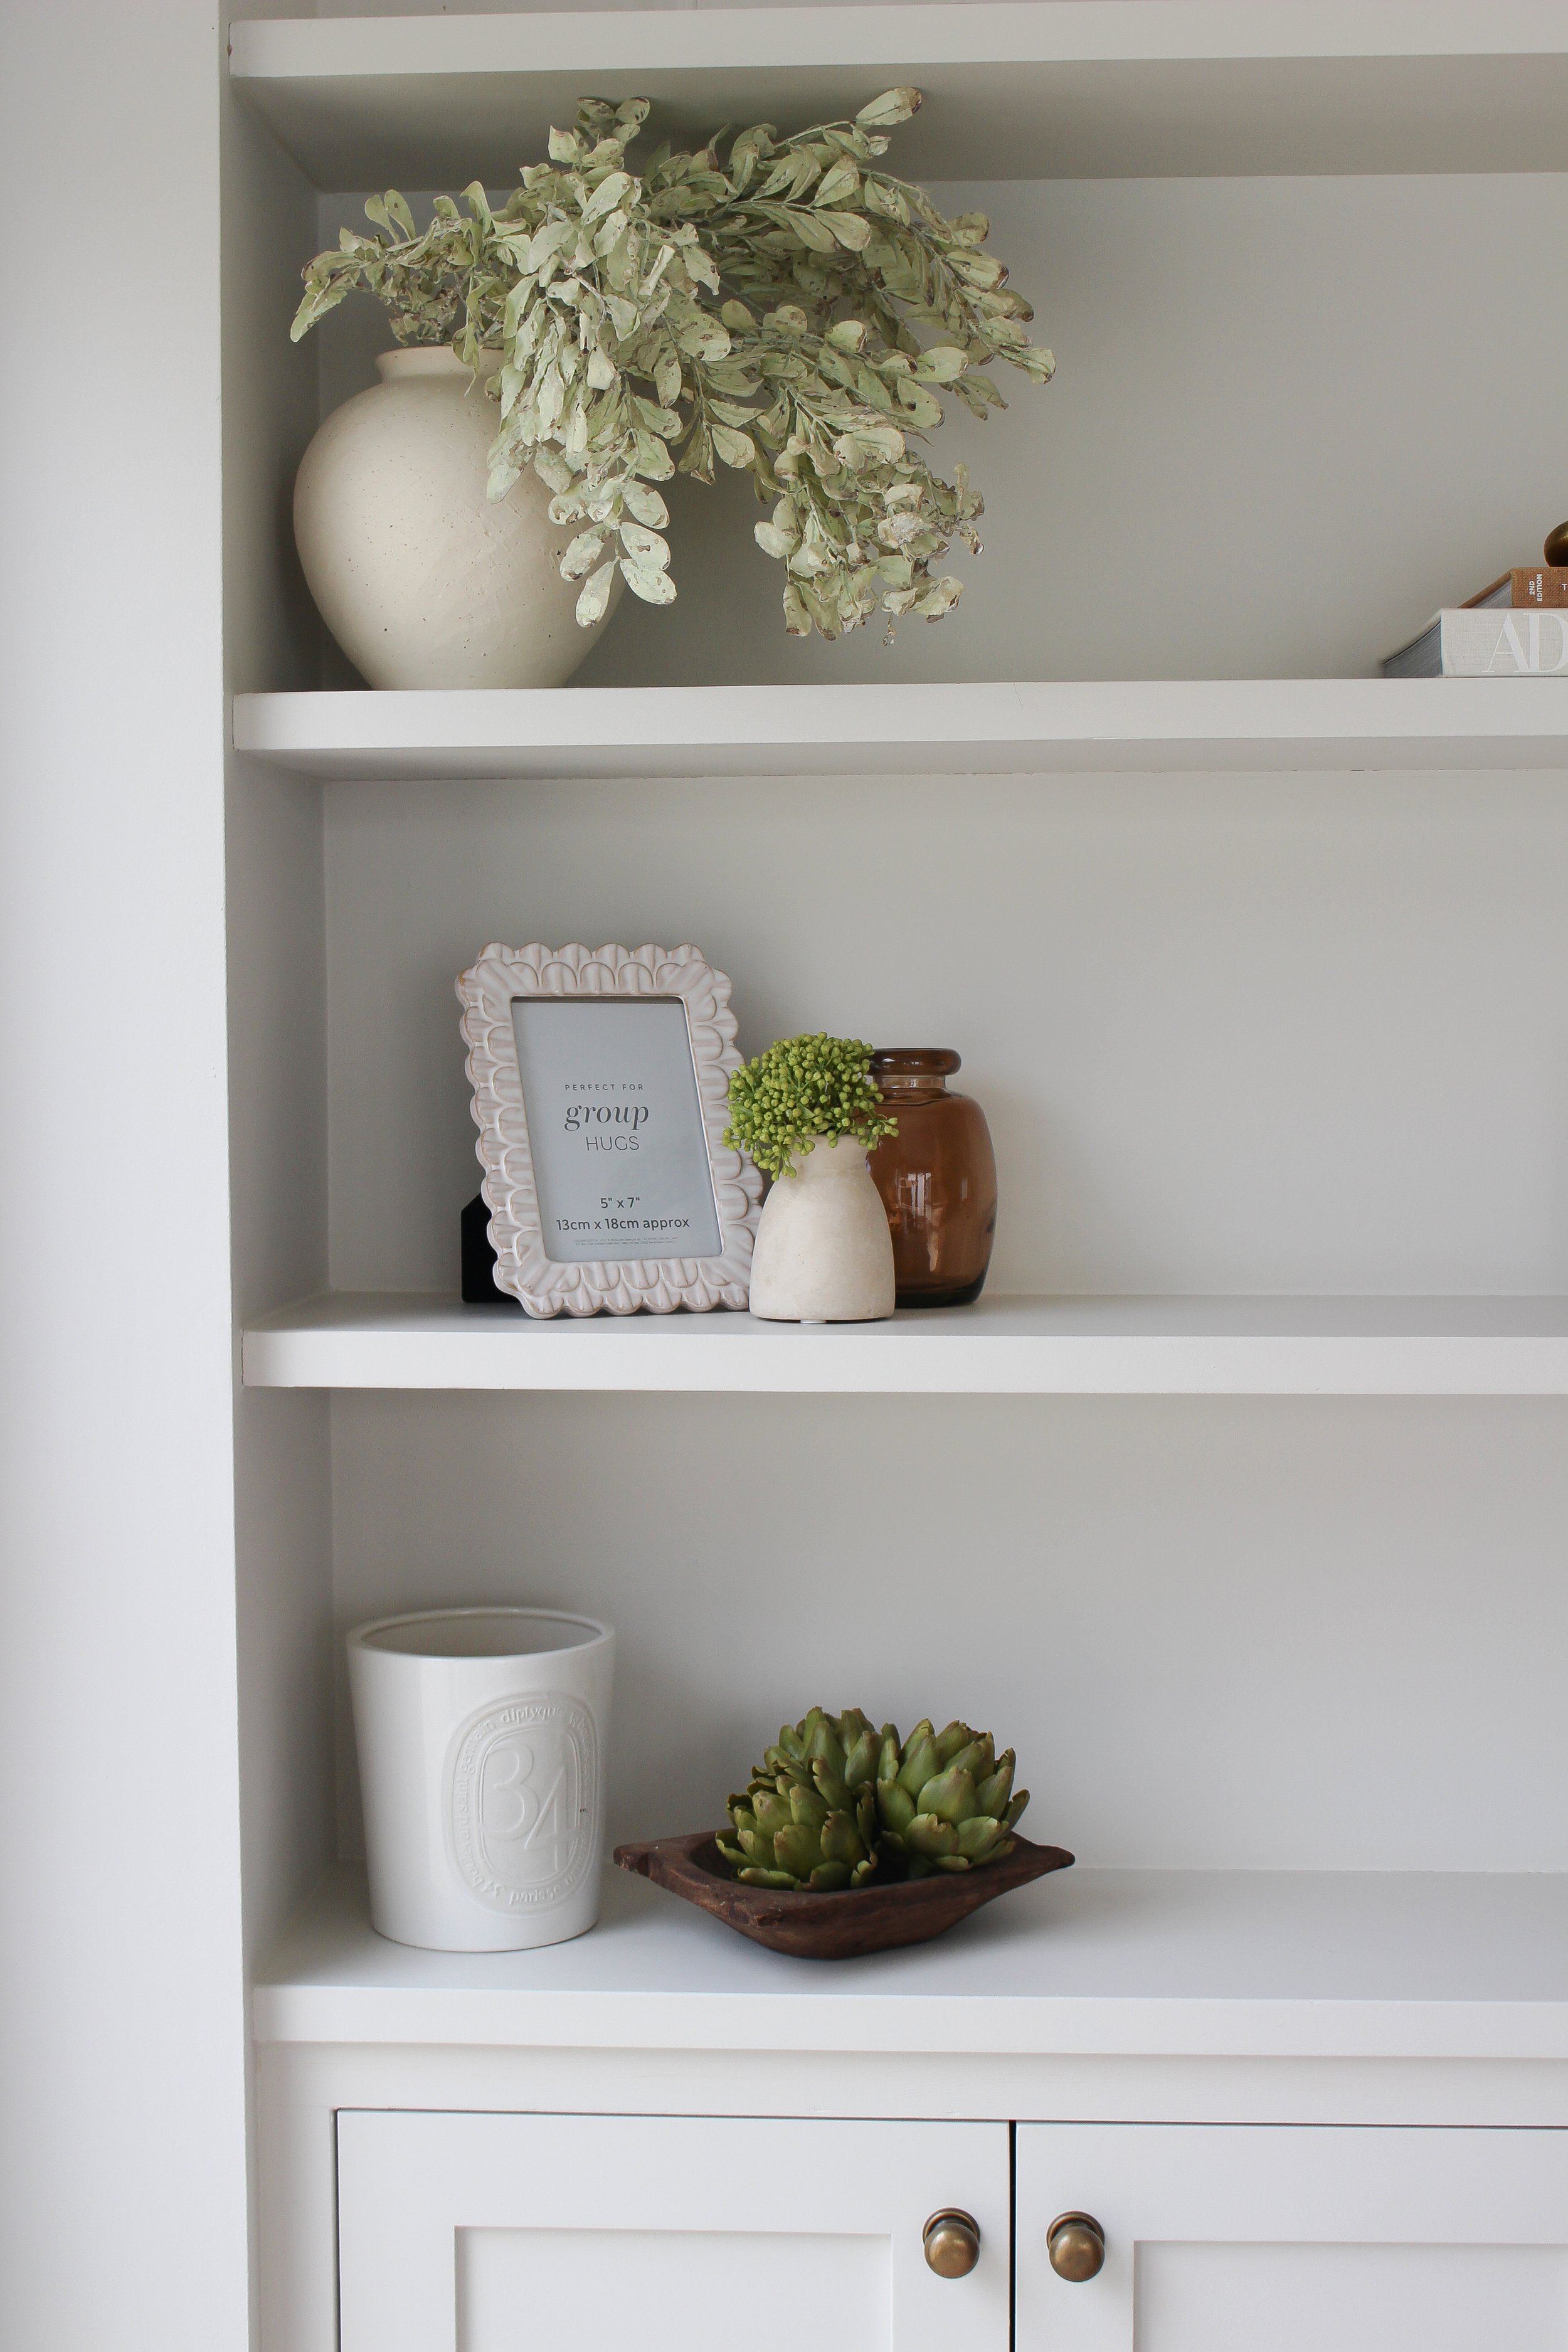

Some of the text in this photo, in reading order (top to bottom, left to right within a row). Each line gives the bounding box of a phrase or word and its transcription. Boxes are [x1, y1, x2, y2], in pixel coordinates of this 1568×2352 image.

[1481, 612, 1568, 673] AD
[622, 1083, 645, 1091] FOR
[564, 1104, 649, 1131] group
[585, 1135, 640, 1152] HUGS
[600, 1196, 641, 1209] 5" x 7"
[556, 1217, 691, 1231] 13cm x 18cm approx
